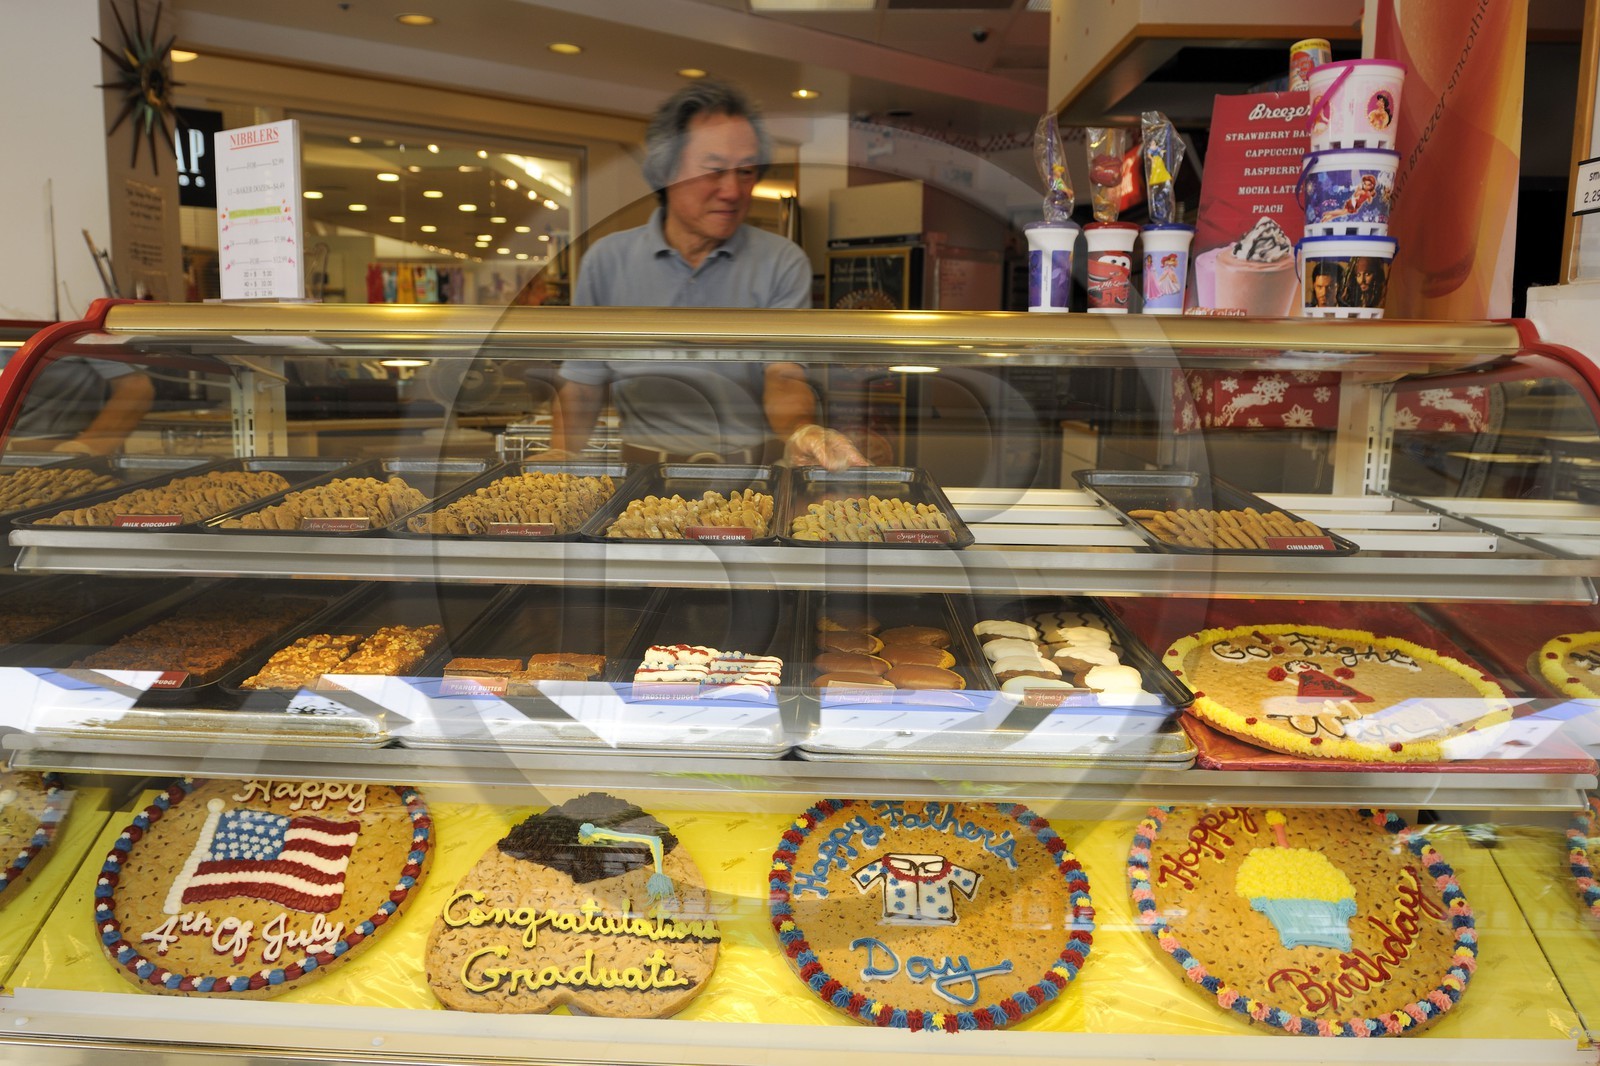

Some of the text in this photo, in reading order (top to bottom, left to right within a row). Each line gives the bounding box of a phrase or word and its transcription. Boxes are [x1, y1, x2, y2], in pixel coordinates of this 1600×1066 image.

[229, 127, 279, 147] NIBBLERS
[1225, 130, 1291, 141] STRAWBERRY
[1245, 147, 1305, 158] CAPPUCCINO
[1244, 166, 1301, 176] RASPBERRY
[1238, 186, 1271, 195] MOCHA
[1252, 204, 1284, 214] PEACH
[1211, 640, 1271, 660] Go
[232, 780, 368, 813] Happy
[793, 814, 885, 899] Happy
[1157, 806, 1448, 1012] Happy Birthday
[141, 911, 345, 962] 4th Of July
[460, 944, 689, 994] Graduate
[849, 937, 1014, 1006] Day
